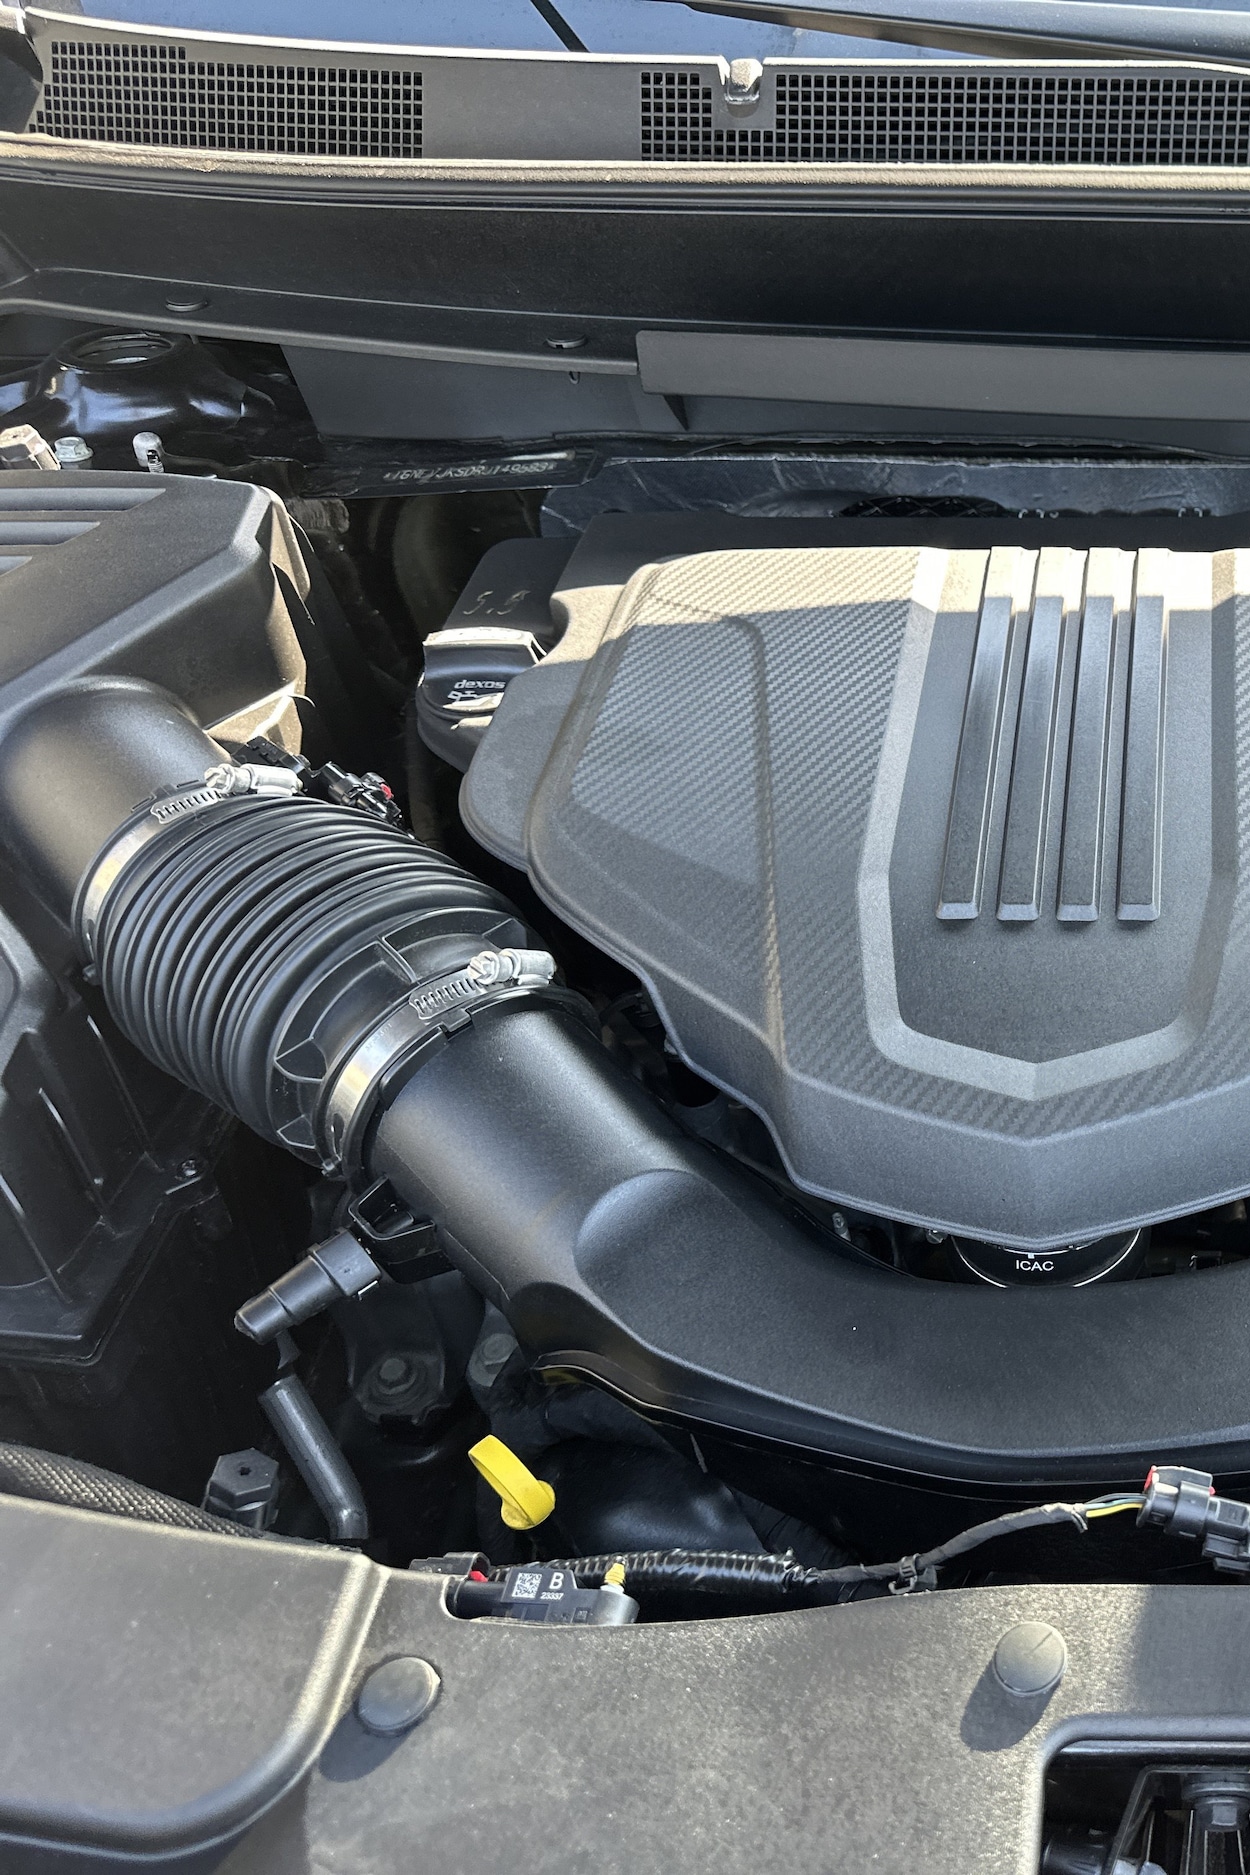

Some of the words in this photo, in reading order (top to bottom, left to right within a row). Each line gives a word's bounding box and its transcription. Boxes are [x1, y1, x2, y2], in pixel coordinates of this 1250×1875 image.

[454, 679, 506, 689] dexos
[1016, 1260, 1054, 1271] ICAC
[549, 1572, 564, 1589] B
